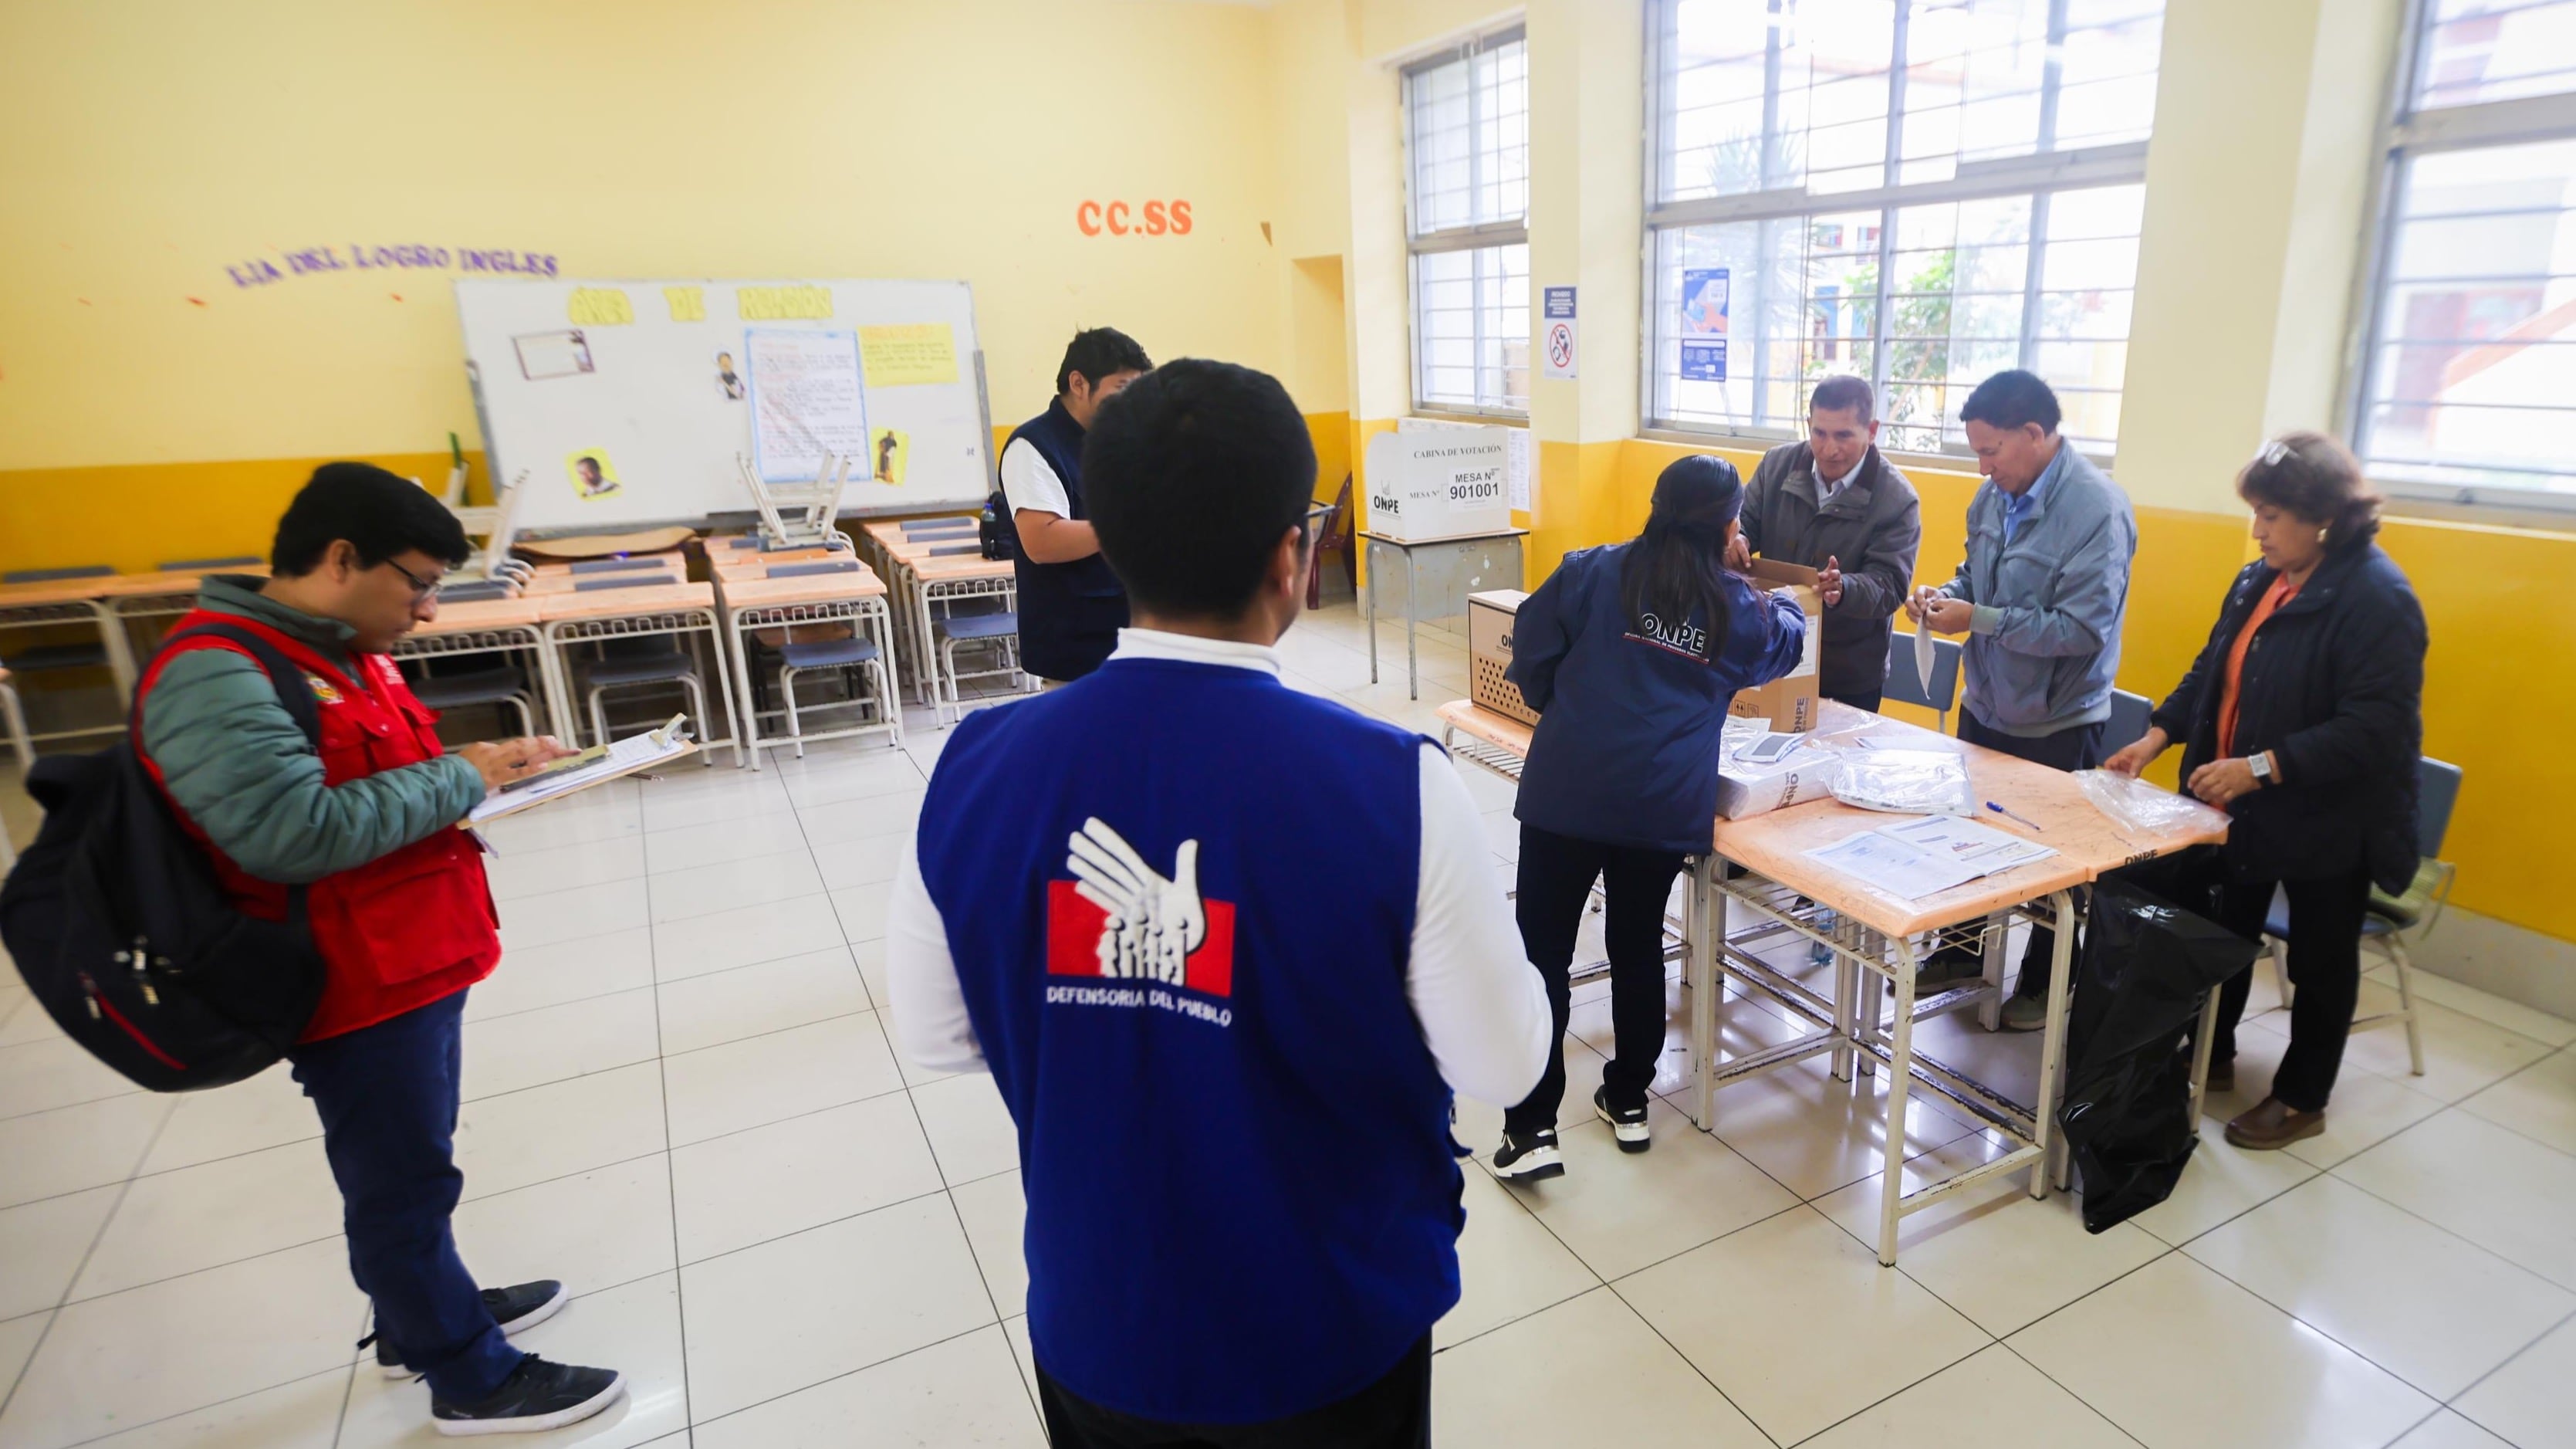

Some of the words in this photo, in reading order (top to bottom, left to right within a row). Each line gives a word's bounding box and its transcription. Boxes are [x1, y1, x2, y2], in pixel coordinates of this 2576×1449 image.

[1077, 199, 1193, 236] CC.SS
[284, 248, 347, 275] DEL
[351, 244, 451, 269] LOGRO
[457, 248, 559, 279] INGLES
[1414, 449, 1445, 459] CABINA
[1448, 449, 1457, 457] DE
[1460, 442, 1502, 455] VOTACIÓN
[1455, 472, 1482, 483] MESA
[1450, 482, 1498, 499] 901001
[1374, 495, 1399, 514] ONPE
[1502, 634, 1513, 648] ON
[1641, 613, 1707, 653] ONPE
[1046, 986, 1145, 1007] DEFENSORIA
[1149, 989, 1175, 1010] DEL
[1178, 997, 1232, 1028] PUEBLO
